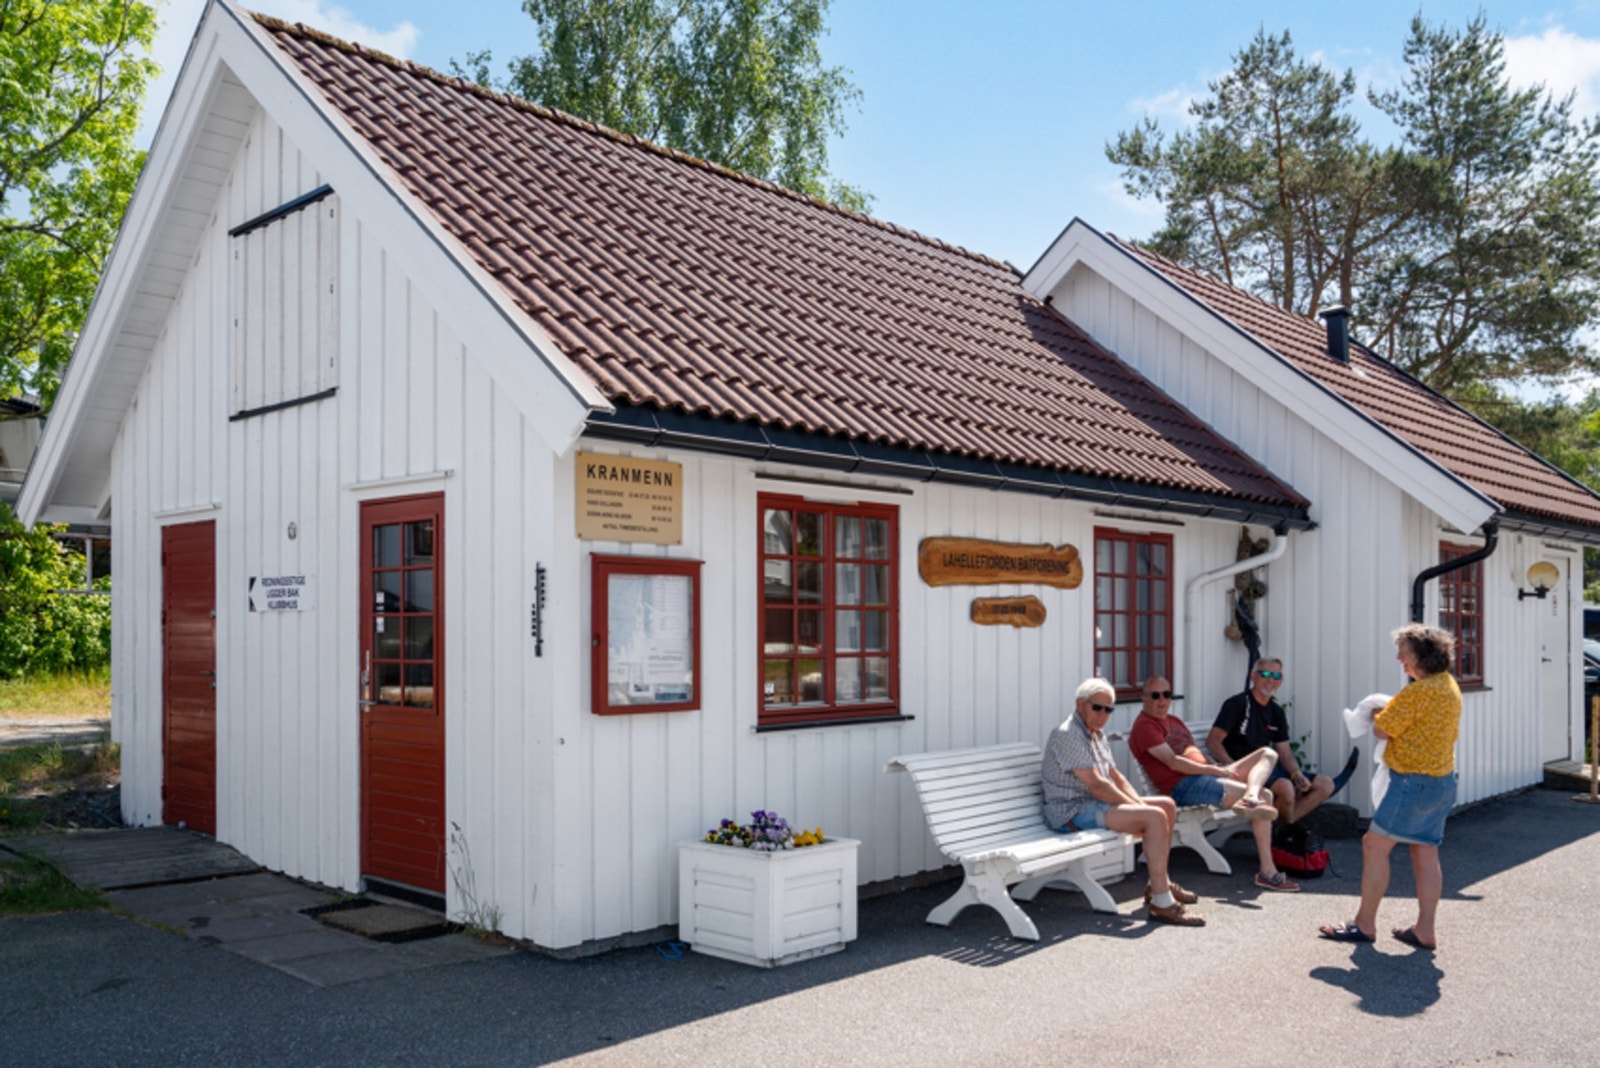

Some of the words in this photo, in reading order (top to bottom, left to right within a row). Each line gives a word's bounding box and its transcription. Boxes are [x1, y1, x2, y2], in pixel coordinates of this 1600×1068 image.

[586, 463, 673, 487] KRANMENN
[1018, 555, 1071, 574] BÅTFORENING
[287, 587, 300, 598] BAK
[267, 600, 298, 609] KLUBBHUS
